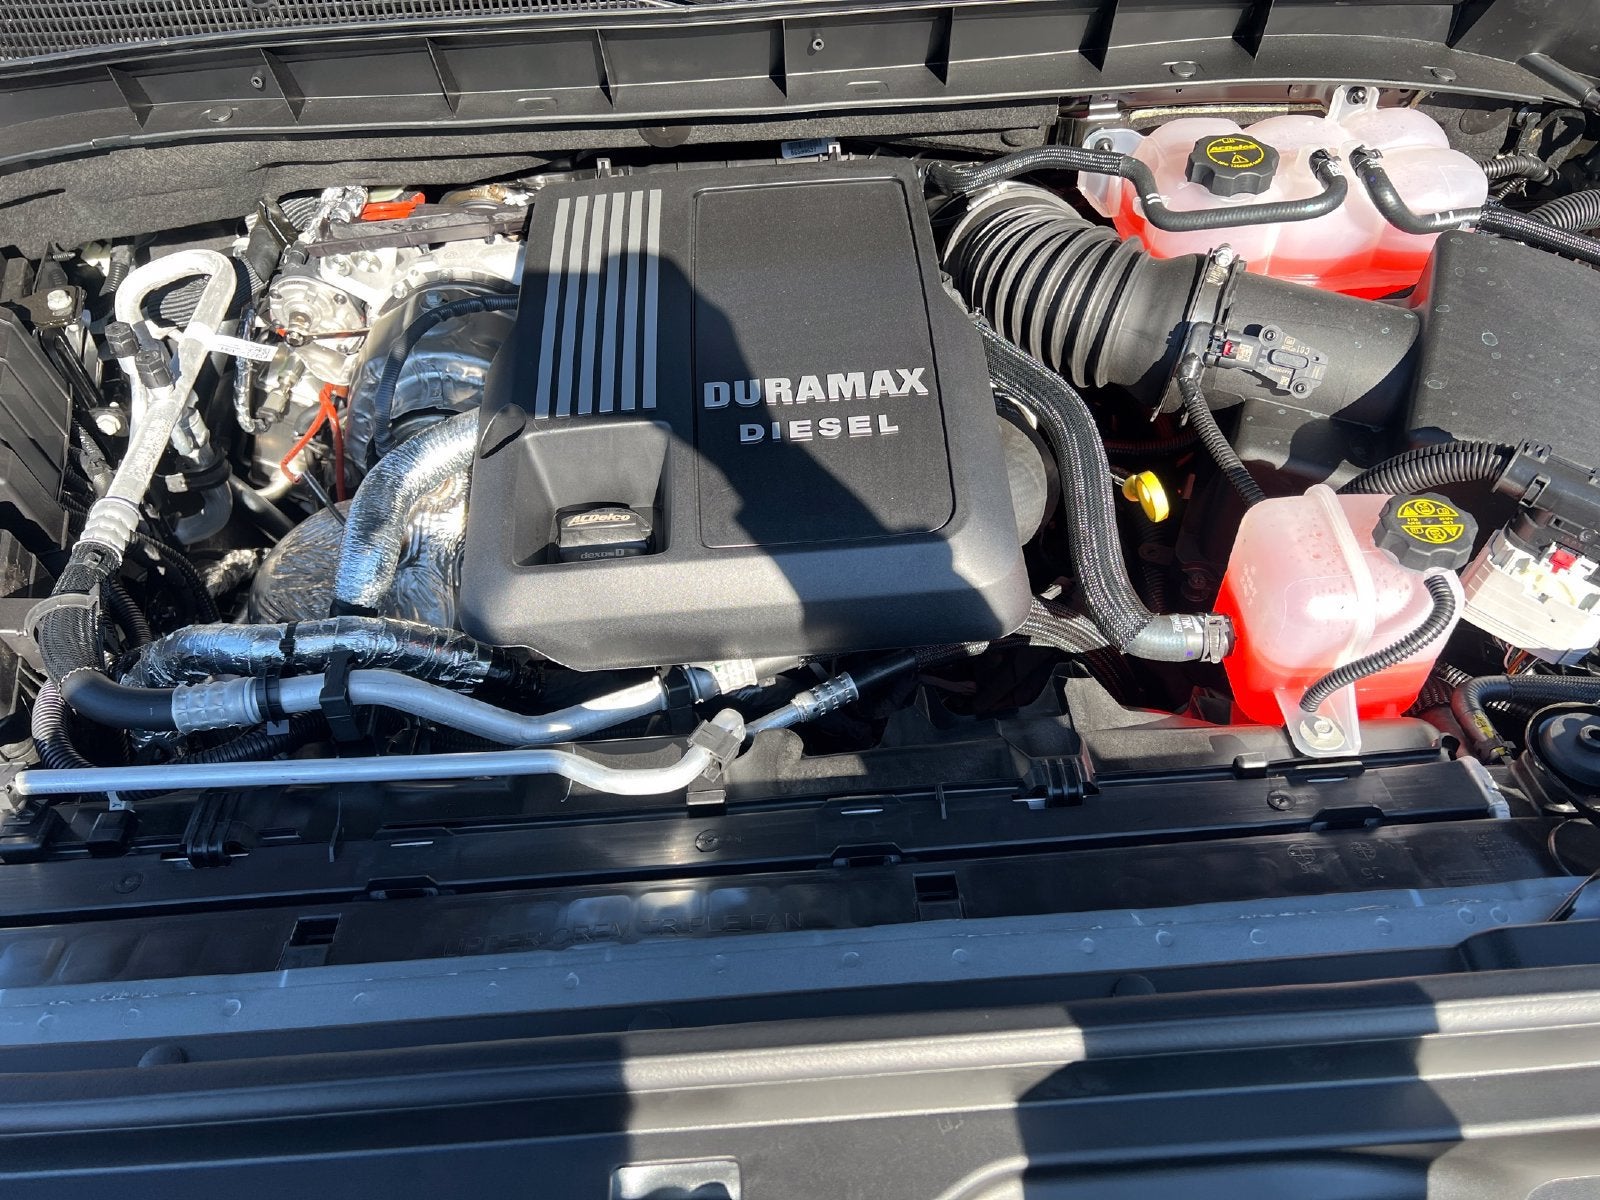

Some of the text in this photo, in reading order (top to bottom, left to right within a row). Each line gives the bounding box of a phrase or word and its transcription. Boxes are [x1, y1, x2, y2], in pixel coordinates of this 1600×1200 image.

[703, 367, 929, 408] DURAMAX
[739, 413, 899, 445] DIESEL
[567, 513, 631, 527] ACDelco
[751, 911, 804, 931] FAN
